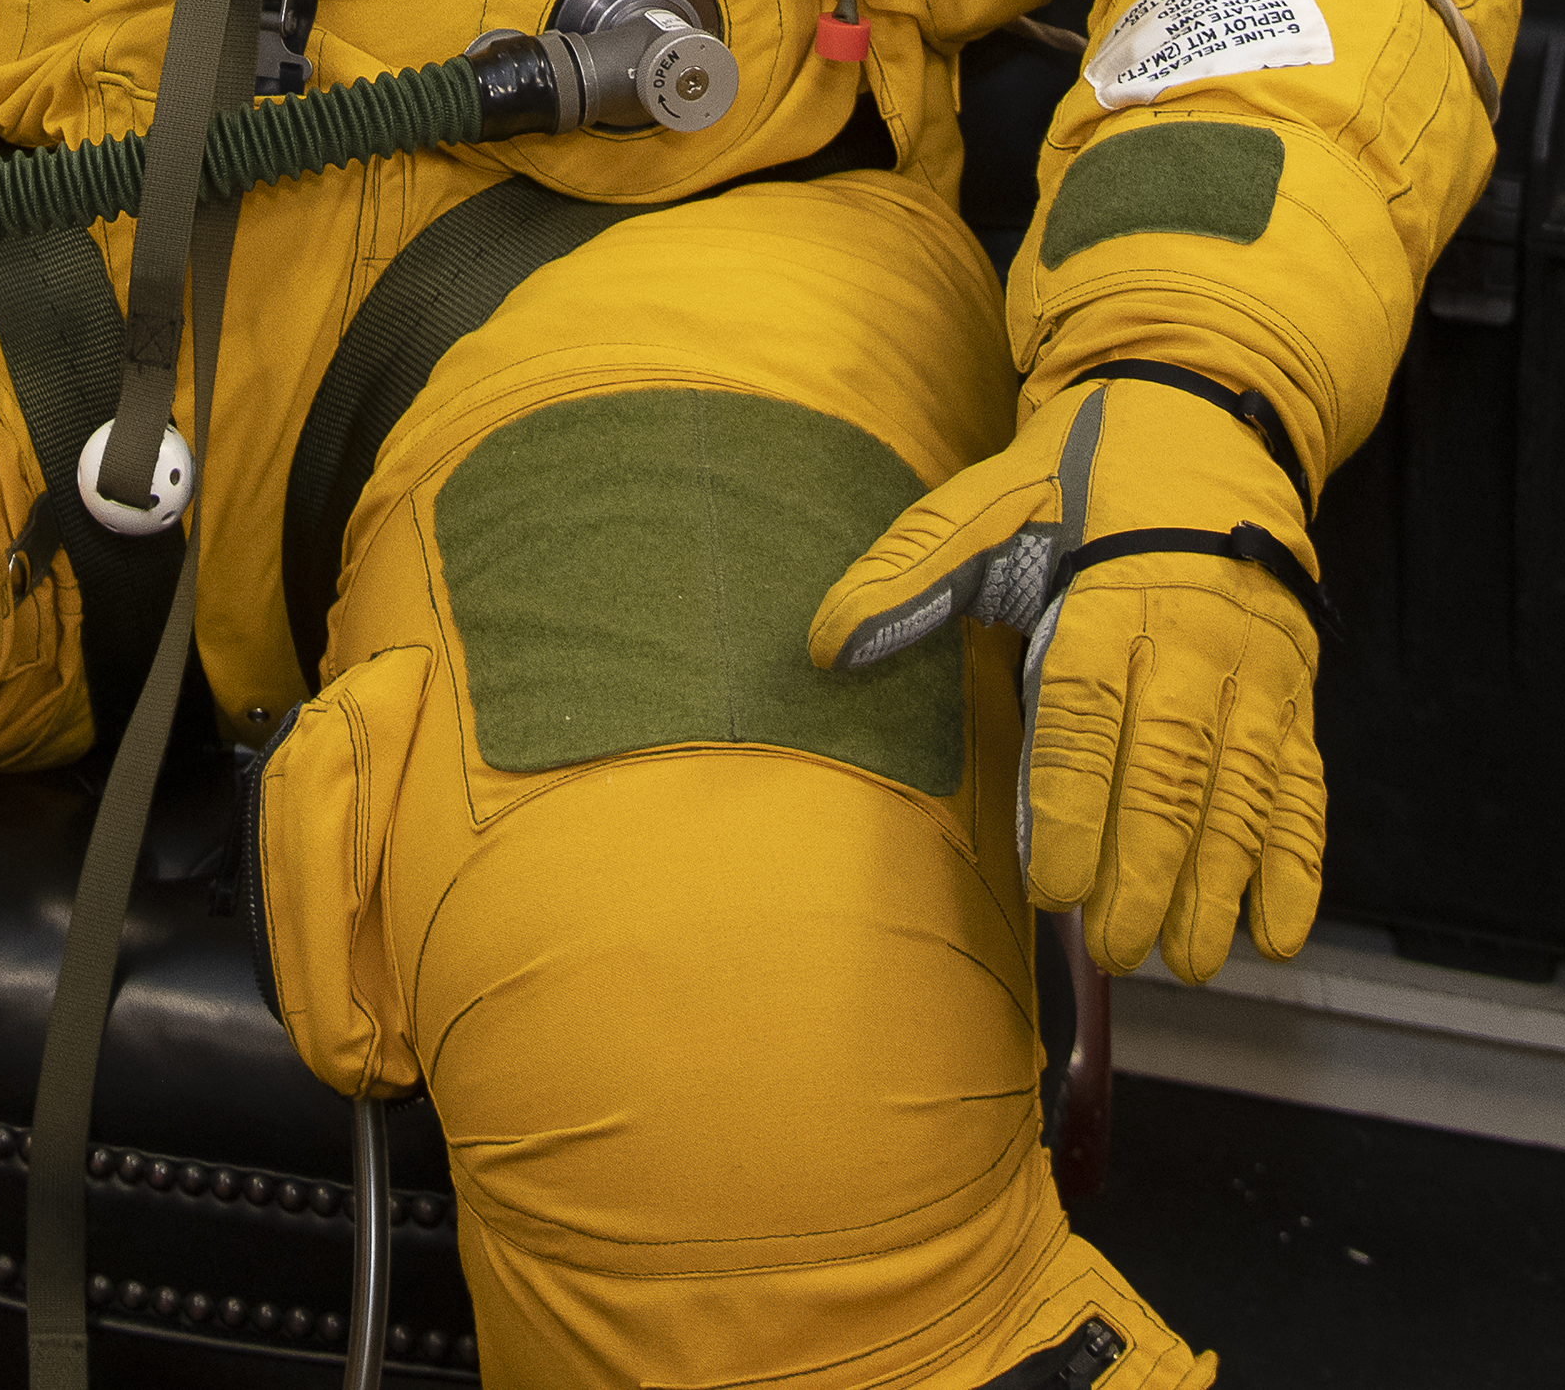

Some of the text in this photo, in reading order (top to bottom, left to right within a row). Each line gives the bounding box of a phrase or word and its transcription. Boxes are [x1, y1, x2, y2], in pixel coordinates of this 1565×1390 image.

[1165, 5, 1218, 36] DOWN
[1210, 0, 1288, 24] INFLATE
[1224, 9, 1295, 36] DEPLOY
[1187, 27, 1217, 51] KIT
[653, 49, 680, 89] OPEN
[1147, 41, 1227, 82] RELEASE
